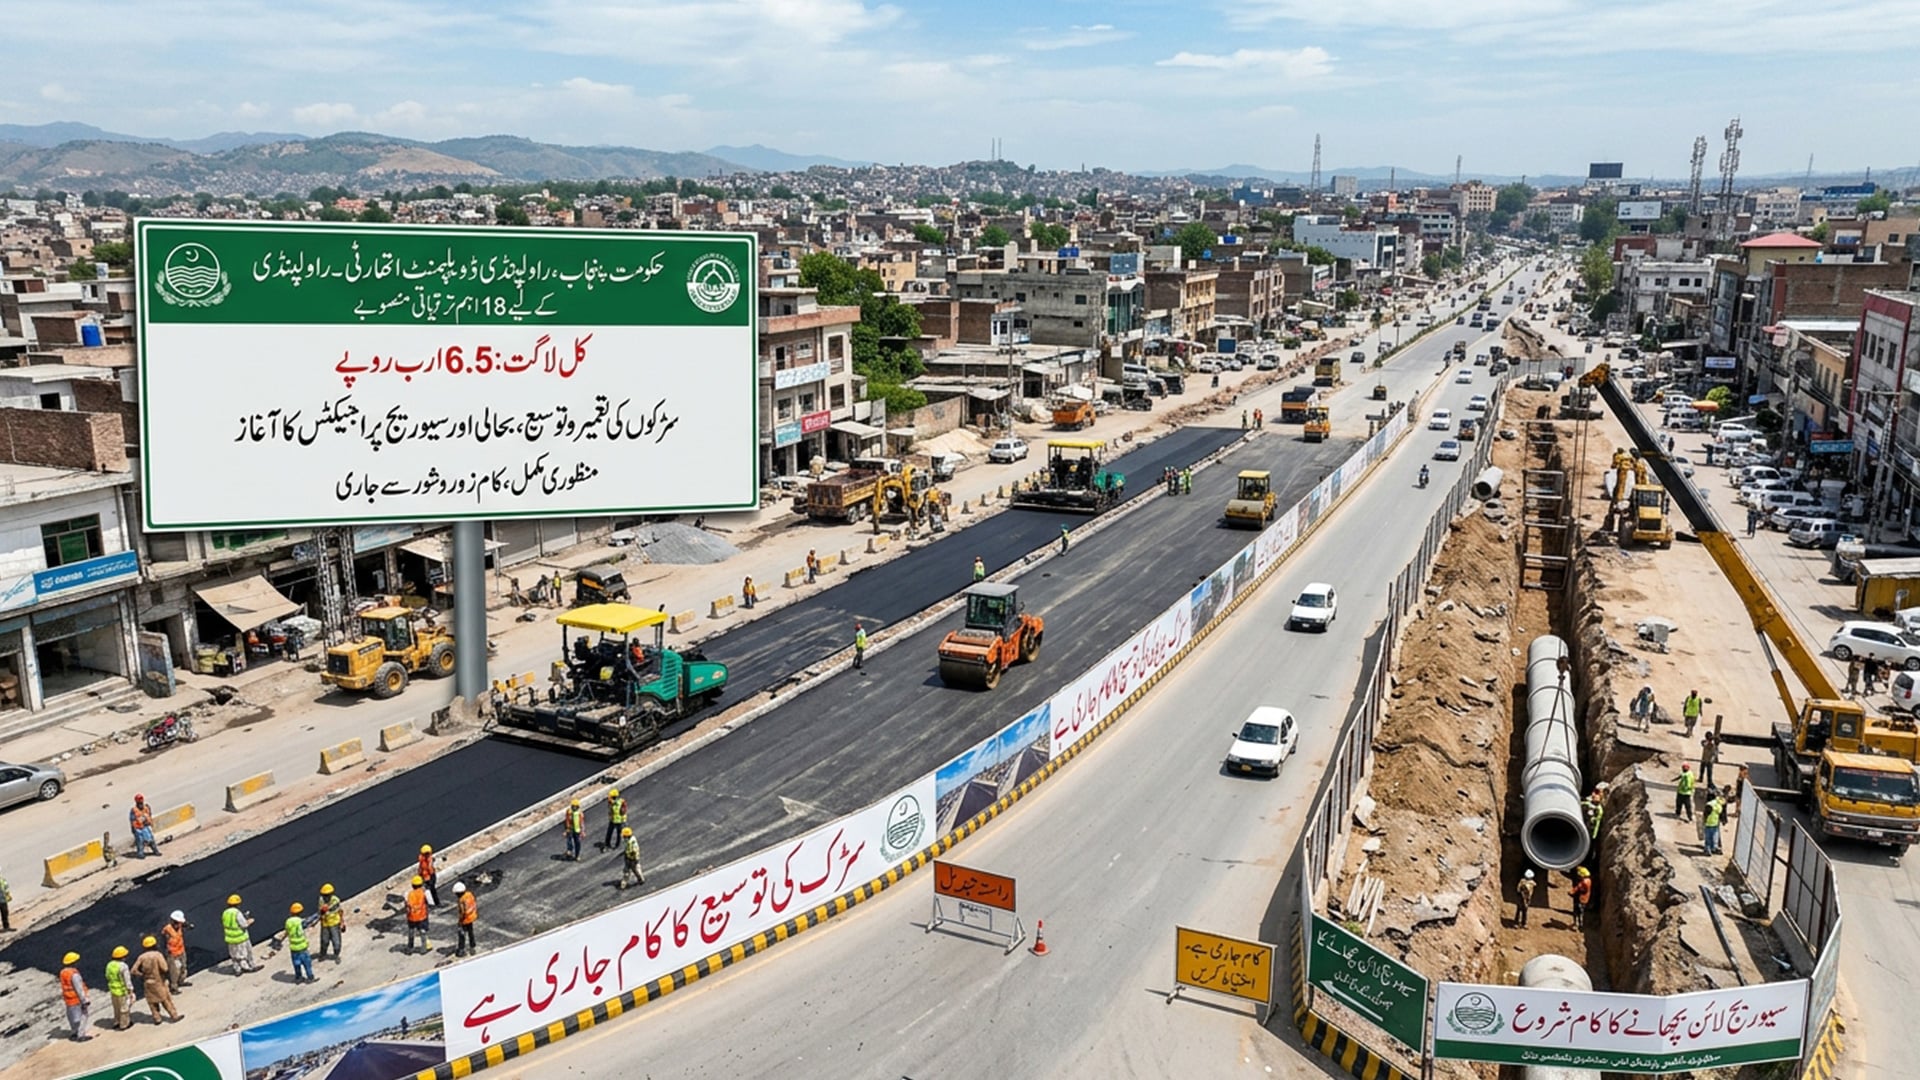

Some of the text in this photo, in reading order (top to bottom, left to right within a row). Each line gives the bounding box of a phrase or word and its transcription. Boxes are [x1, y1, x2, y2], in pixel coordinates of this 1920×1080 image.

[252, 250, 331, 286] راولپنڈی
[479, 254, 551, 289] راولپنڈی
[609, 250, 667, 282] حکومت
[353, 292, 410, 320] منصوبے
[455, 295, 479, 324] اہم
[481, 296, 507, 316] 18
[508, 287, 532, 321] لیے
[534, 292, 558, 315] کے
[335, 350, 393, 389] روپے
[395, 347, 443, 383] ارب
[446, 345, 493, 374] 6.5
[559, 333, 594, 378] کل
[234, 408, 282, 442] آغاز
[282, 409, 302, 442] کا
[386, 404, 449, 445] سیوریج
[446, 414, 473, 439] اور
[475, 407, 515, 442] بحالی
[606, 398, 631, 440] کی
[626, 398, 680, 444] سڑکوں
[336, 471, 379, 504] جاری
[381, 480, 411, 496] سے
[477, 466, 507, 504] کام
[543, 461, 599, 496] منظوری
[463, 828, 866, 1044] سڑک کی توسیع کا کام جاری ہے
[1512, 999, 1789, 1047] سیوریج لائن بچھانے کا کام شروع
